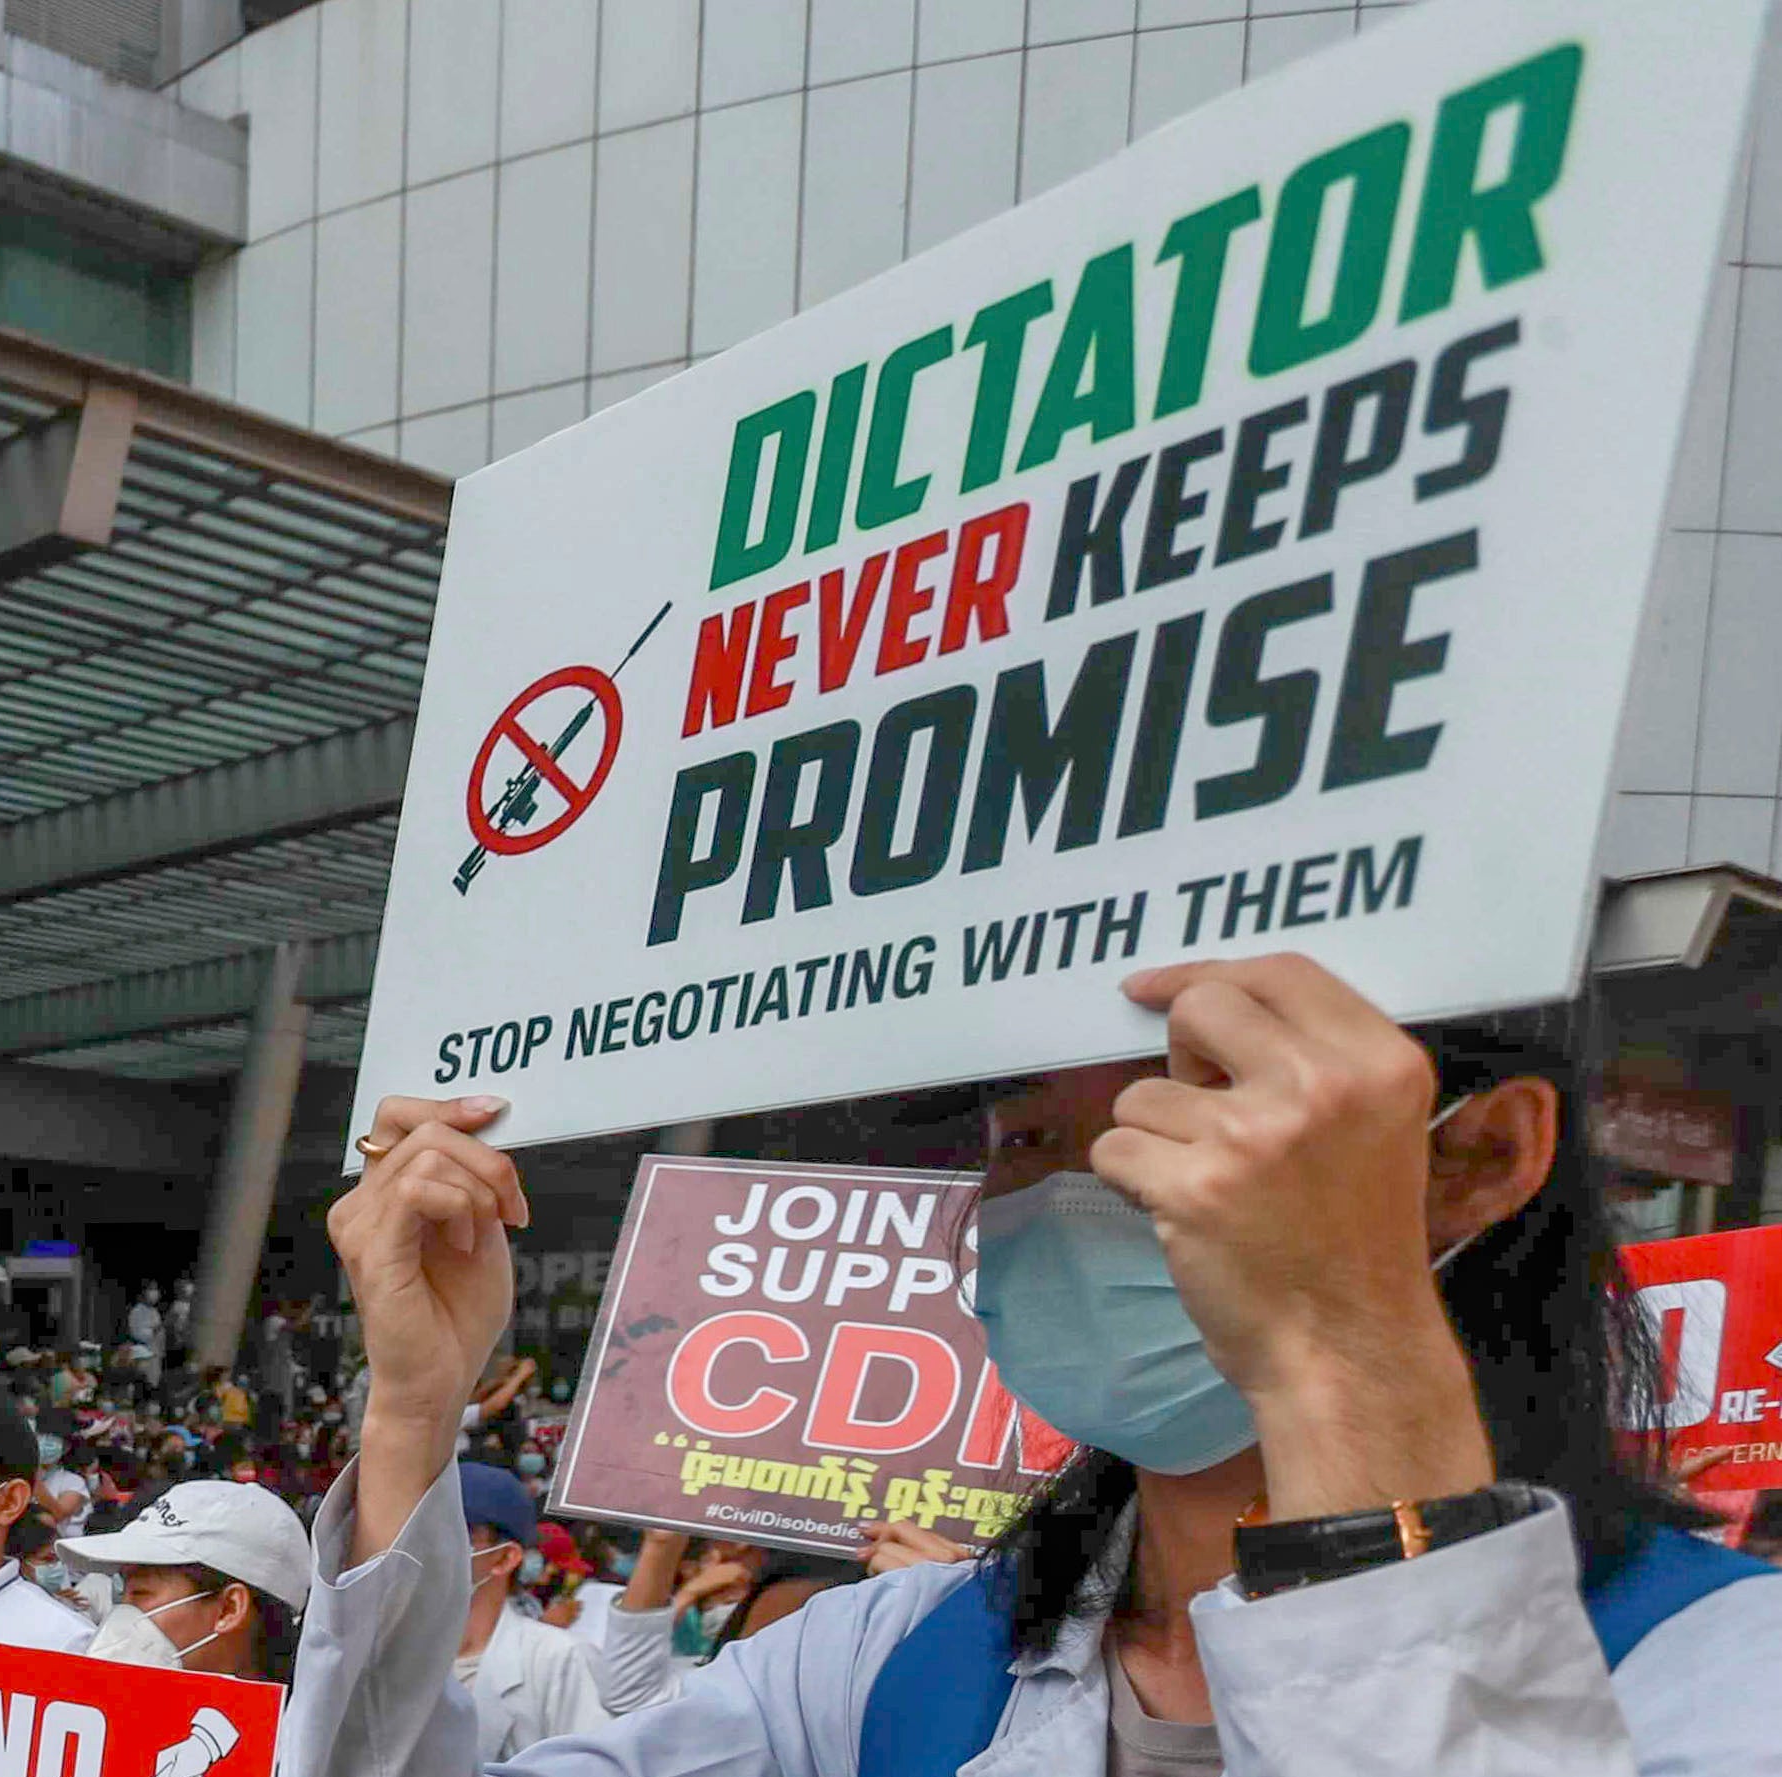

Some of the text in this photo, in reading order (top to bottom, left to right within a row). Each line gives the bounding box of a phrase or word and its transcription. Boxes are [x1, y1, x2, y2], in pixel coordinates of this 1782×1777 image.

[710, 43, 1584, 590] DICTATOR
[682, 319, 1522, 737] NEVER KEEPS
[647, 529, 1480, 946] PROMISE
[434, 837, 1423, 1085] STOP NEGOTIATING WITH THEM
[698, 1243, 977, 1319] SUPP
[713, 1183, 936, 1249] JOIN
[705, 1504, 864, 1540] #CivilDisobedie
